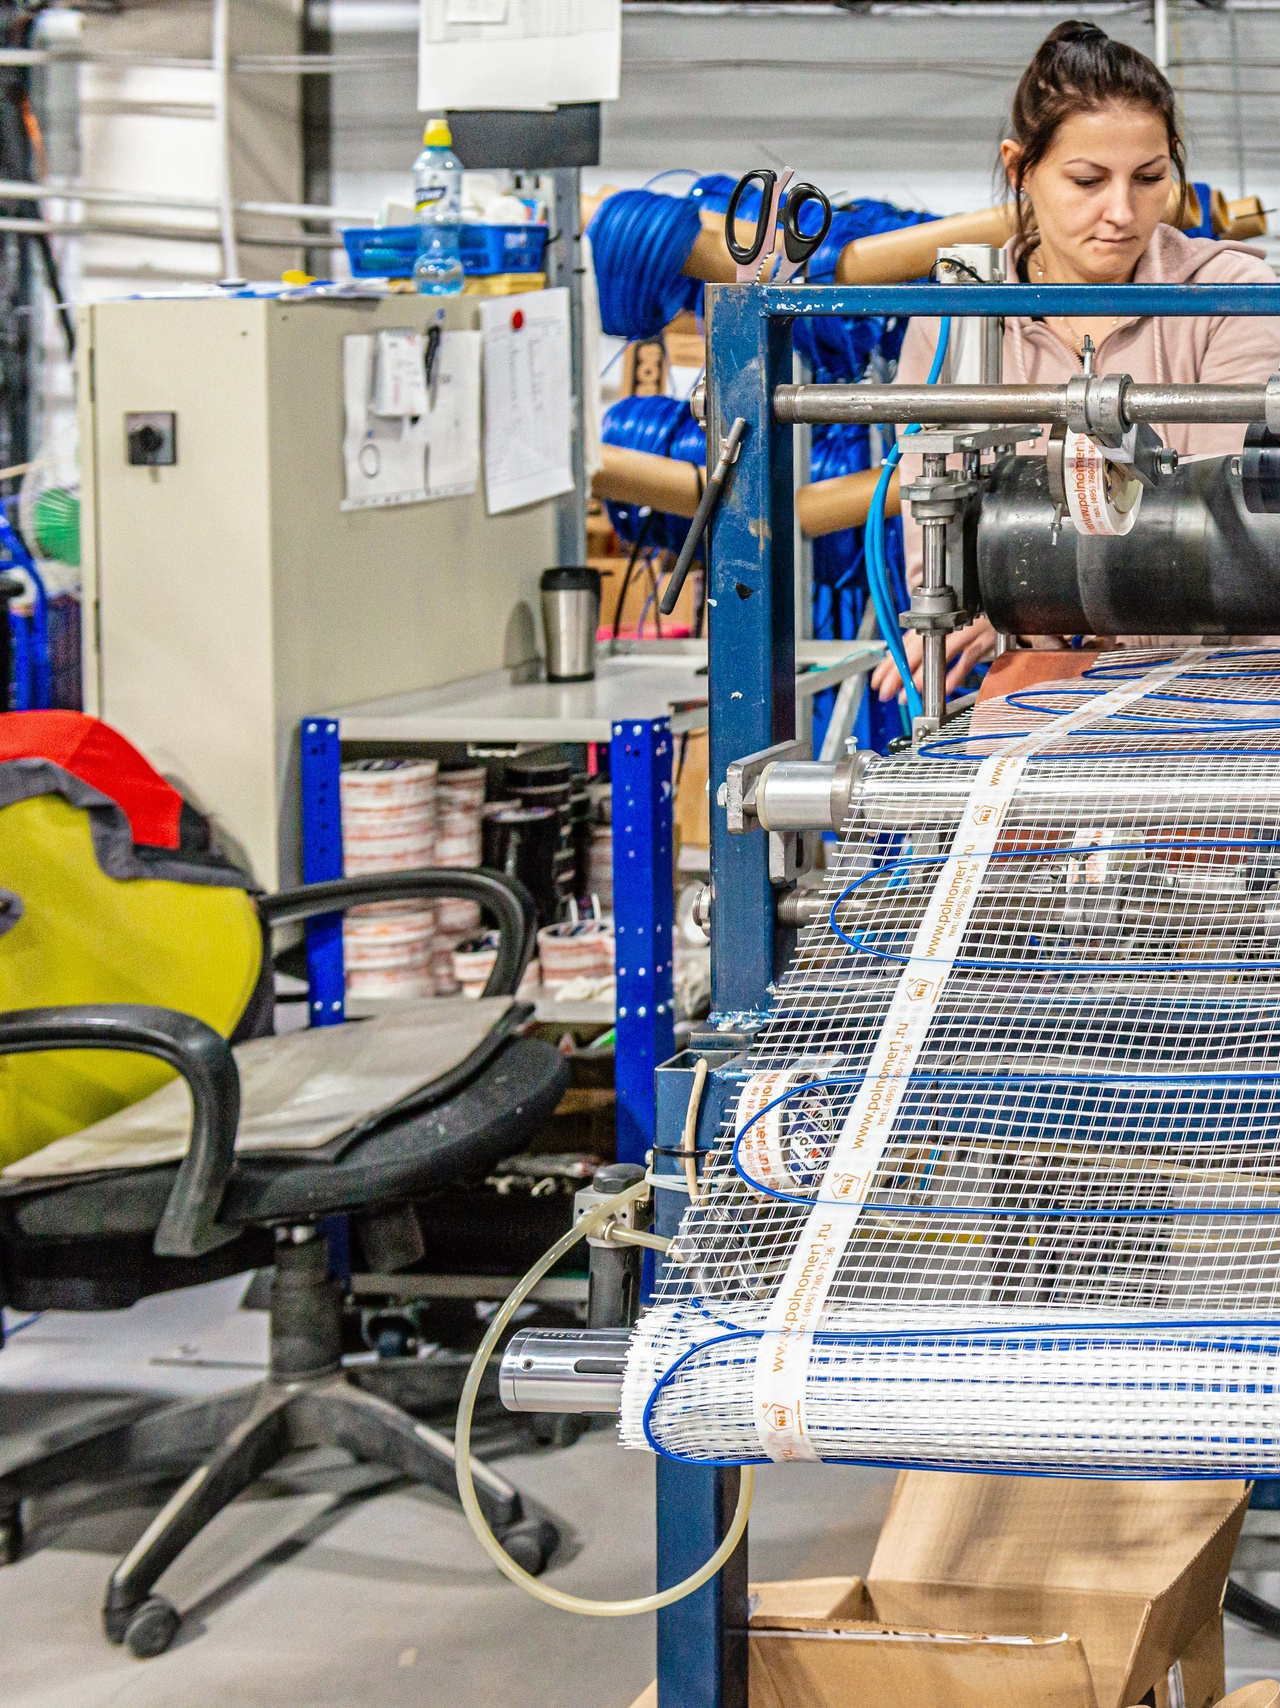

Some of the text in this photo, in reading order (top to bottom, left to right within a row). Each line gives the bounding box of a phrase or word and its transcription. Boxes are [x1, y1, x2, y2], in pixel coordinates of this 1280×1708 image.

[1090, 486, 1098, 504] (495)
[926, 844, 975, 957] www.polnomer1.ru
[953, 900, 967, 920] (495)
[960, 863, 980, 899] 780-71-36
[852, 1022, 909, 1150] www.polnomer1.ru
[882, 1085, 898, 1107] (495)
[891, 1042, 914, 1083] 780-71-36
[810, 1245, 836, 1292] 780-71-36
[802, 1292, 819, 1318] (495)
